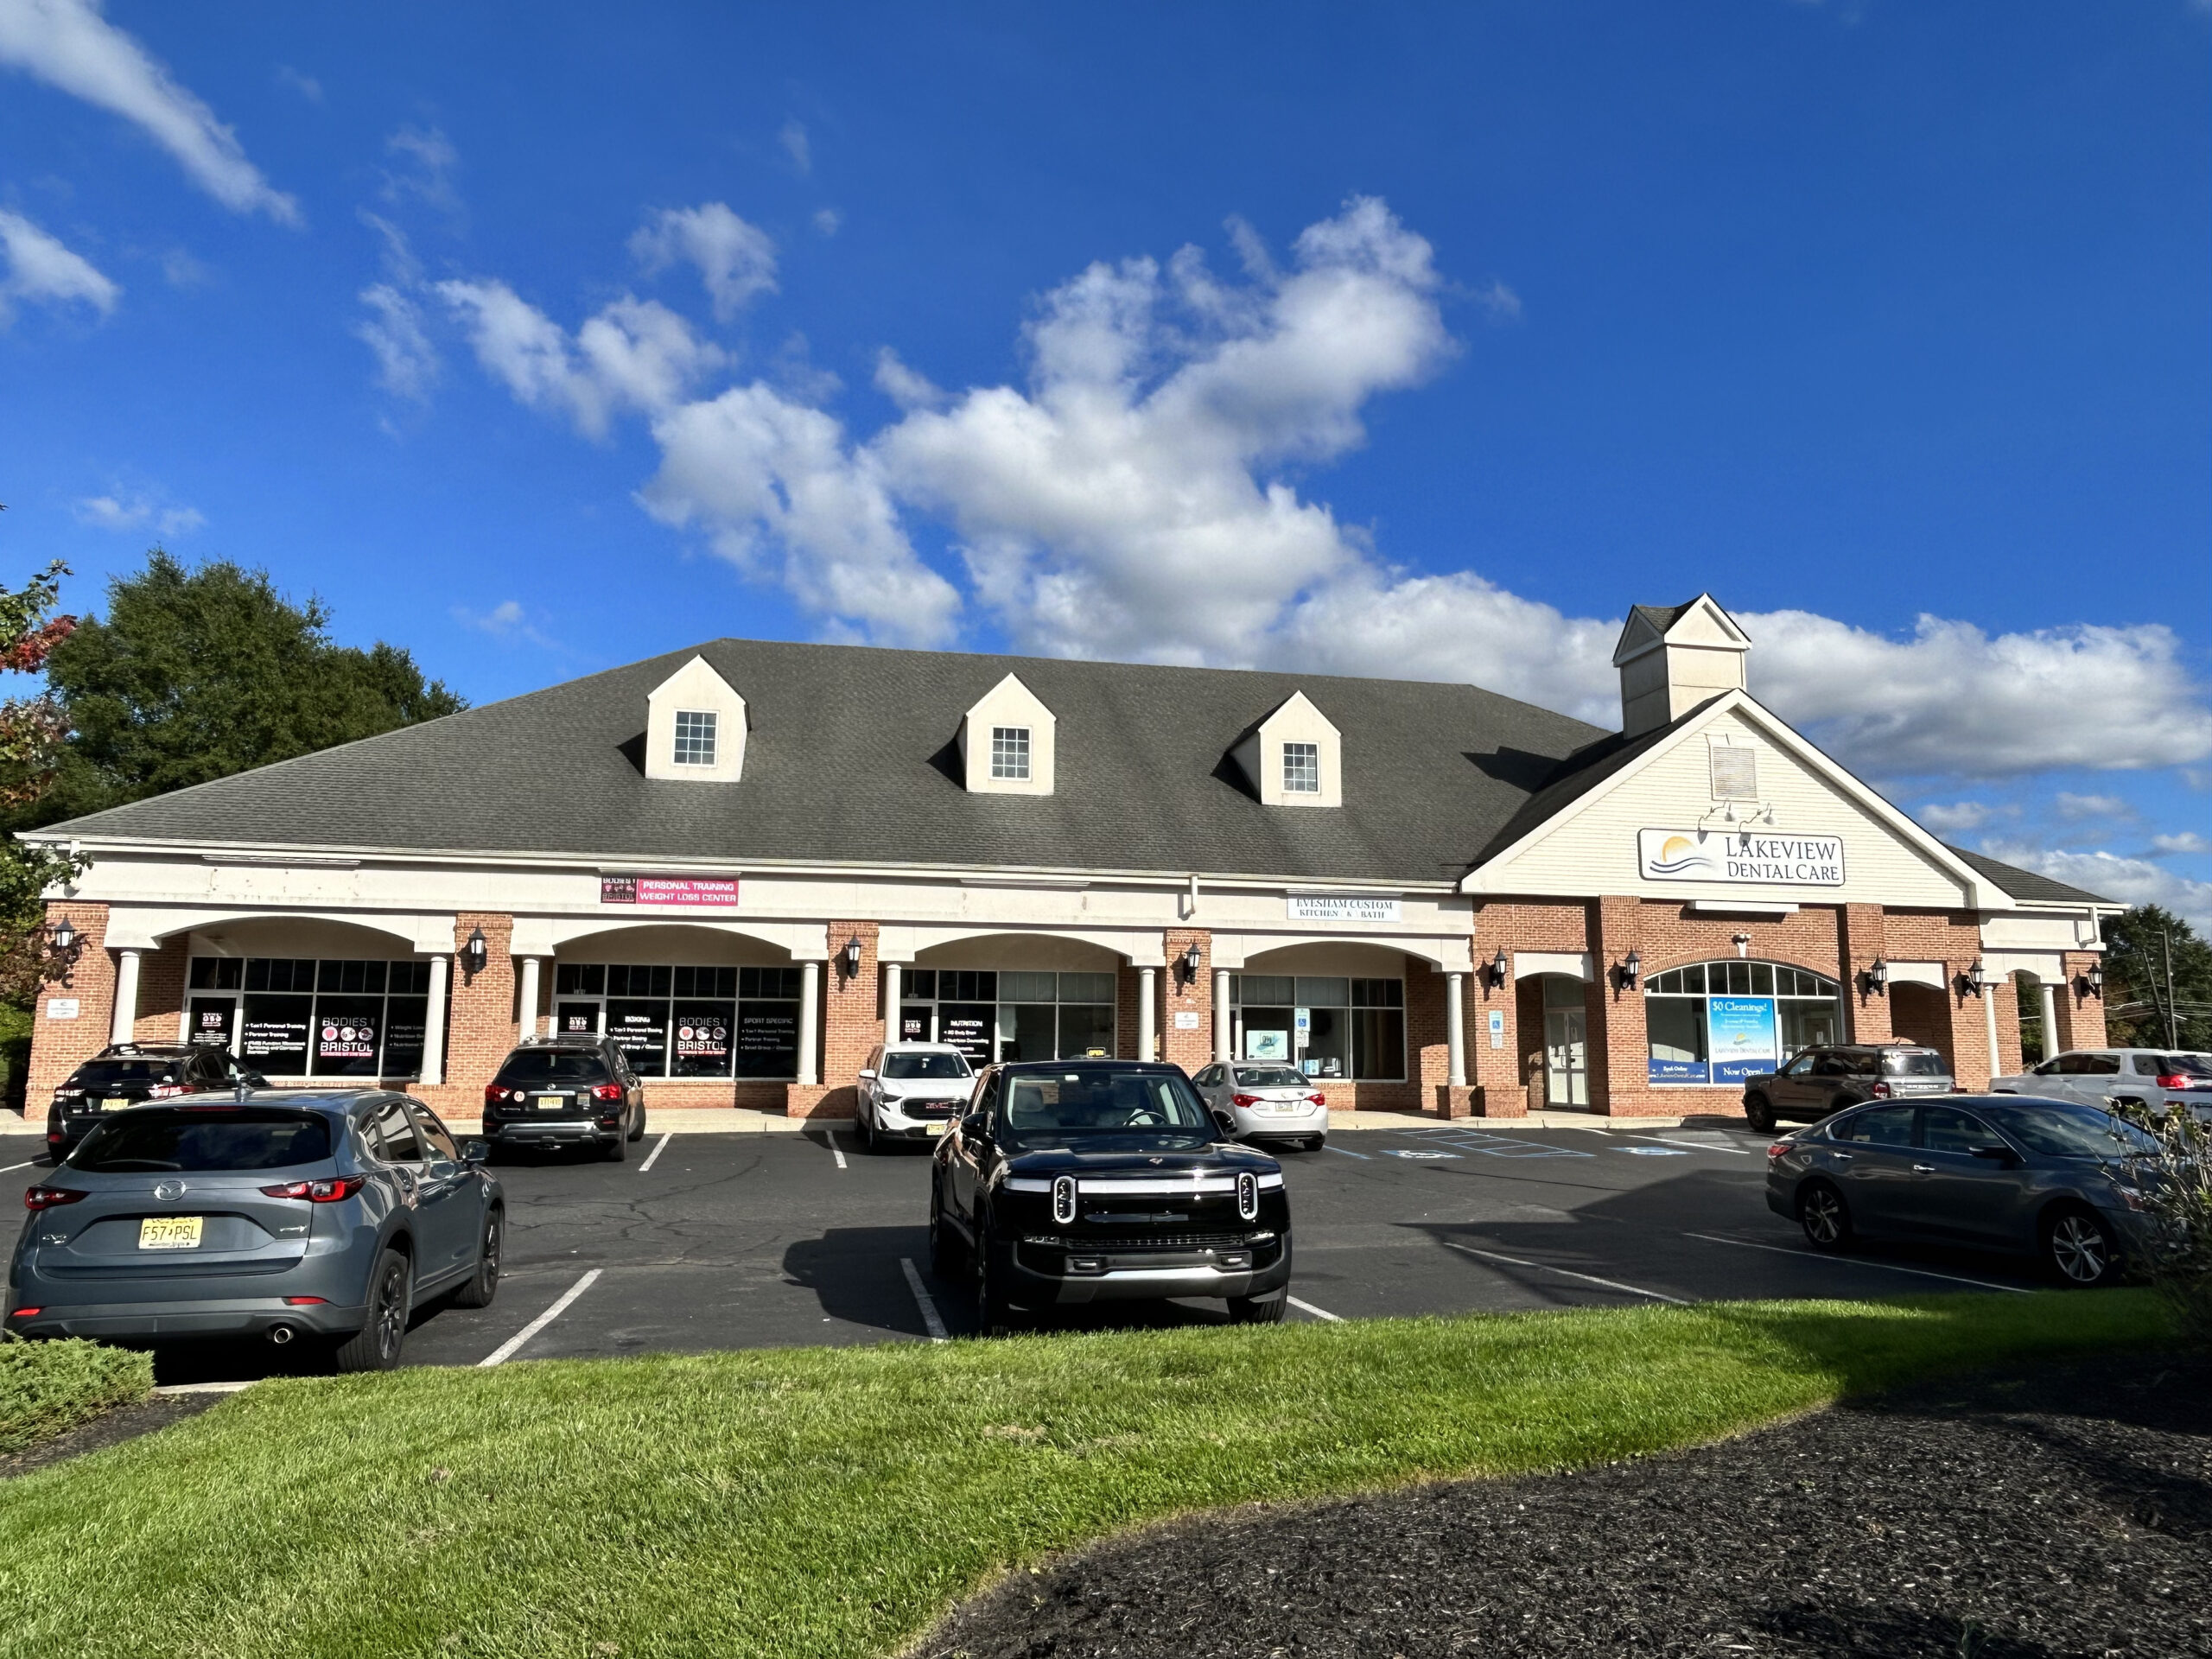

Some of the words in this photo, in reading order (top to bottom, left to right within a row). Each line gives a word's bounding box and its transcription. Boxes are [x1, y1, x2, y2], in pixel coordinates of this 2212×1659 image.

[1726, 836, 1836, 860] LAKEVIEW
[1727, 861, 1794, 879] DENTAL
[1796, 864, 1840, 880] CARE
[643, 881, 690, 891] PERSONAL
[693, 882, 734, 891] TRAINING
[639, 893, 676, 901] WEIGHT
[677, 893, 699, 901] LOSS
[702, 893, 736, 902] CENTER
[1350, 900, 1393, 910] CUSTOM
[1713, 1001, 1724, 1011] $0
[1725, 1001, 1767, 1013] Cleanings!
[322, 1017, 367, 1027] BODIES
[679, 1017, 720, 1027] BODIES
[321, 1042, 373, 1052] BRISTOL
[677, 1041, 727, 1051] BRISTOL
[1723, 1067, 1739, 1076] Now
[1741, 1067, 1763, 1077] Open!
